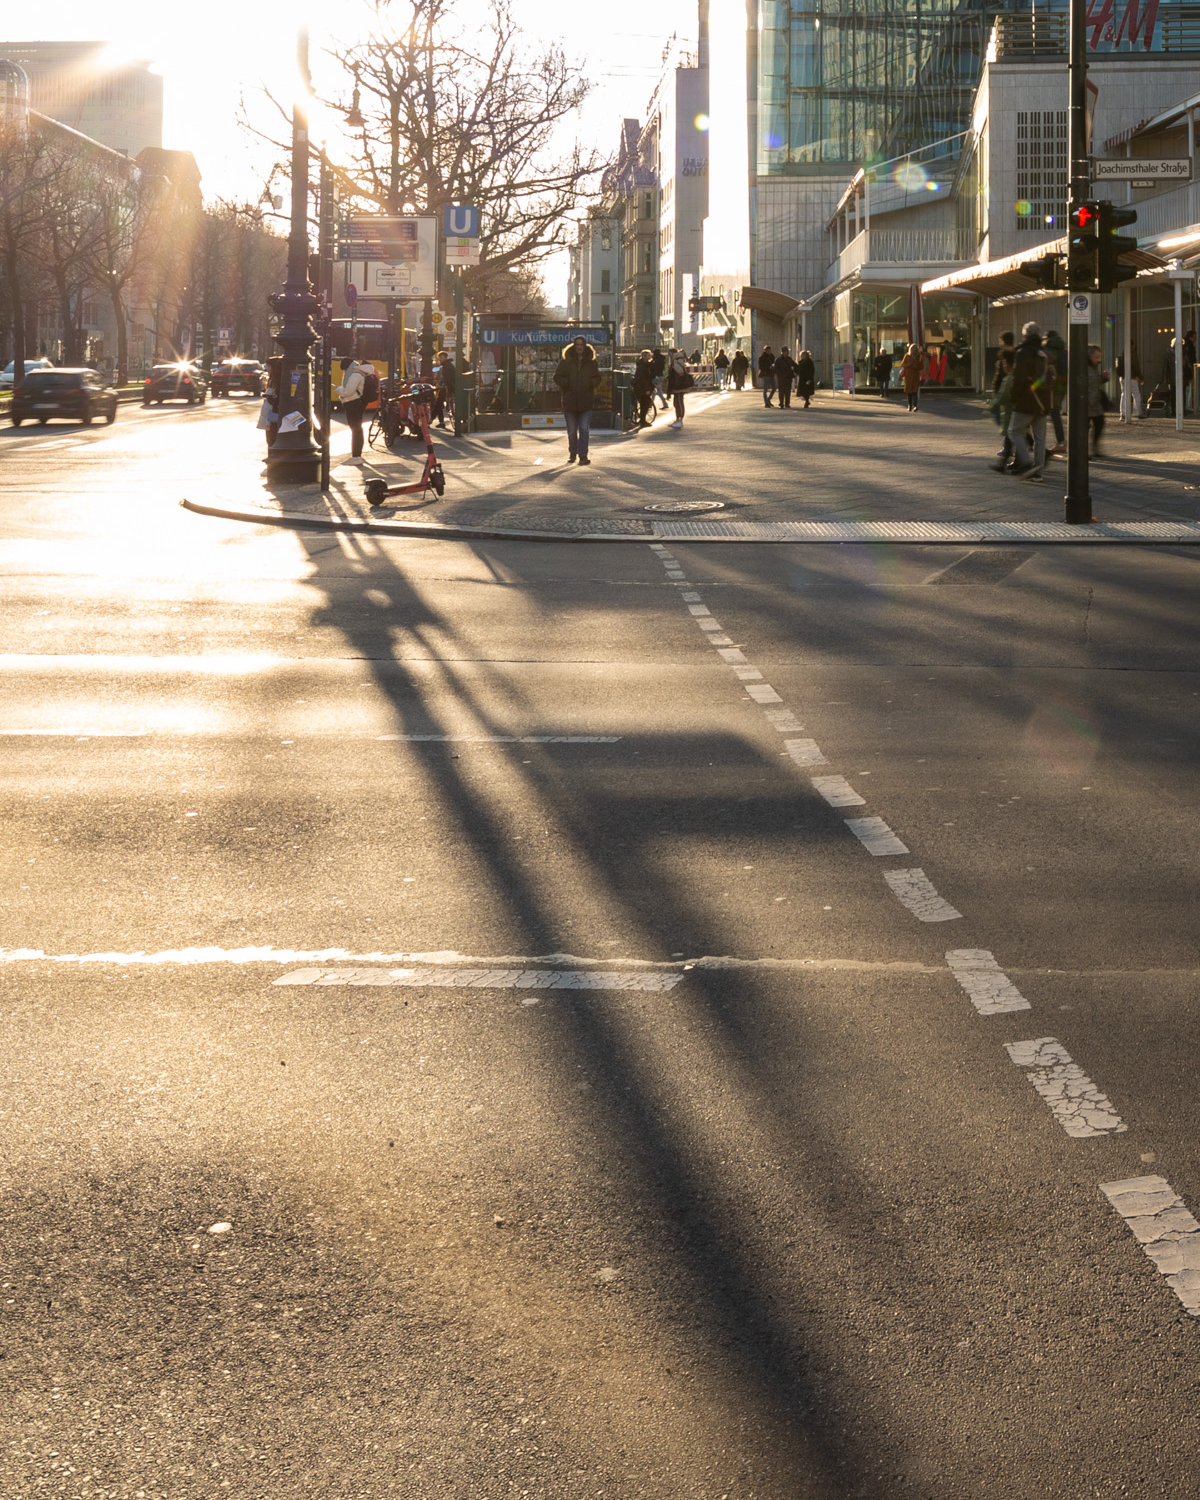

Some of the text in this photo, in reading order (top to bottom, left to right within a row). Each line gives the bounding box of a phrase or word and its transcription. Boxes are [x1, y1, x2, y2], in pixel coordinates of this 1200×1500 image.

[1097, 162, 1188, 175] Joachimsthaler Straße
[450, 209, 471, 234] U
[483, 331, 595, 343] U Kurfürstendam
